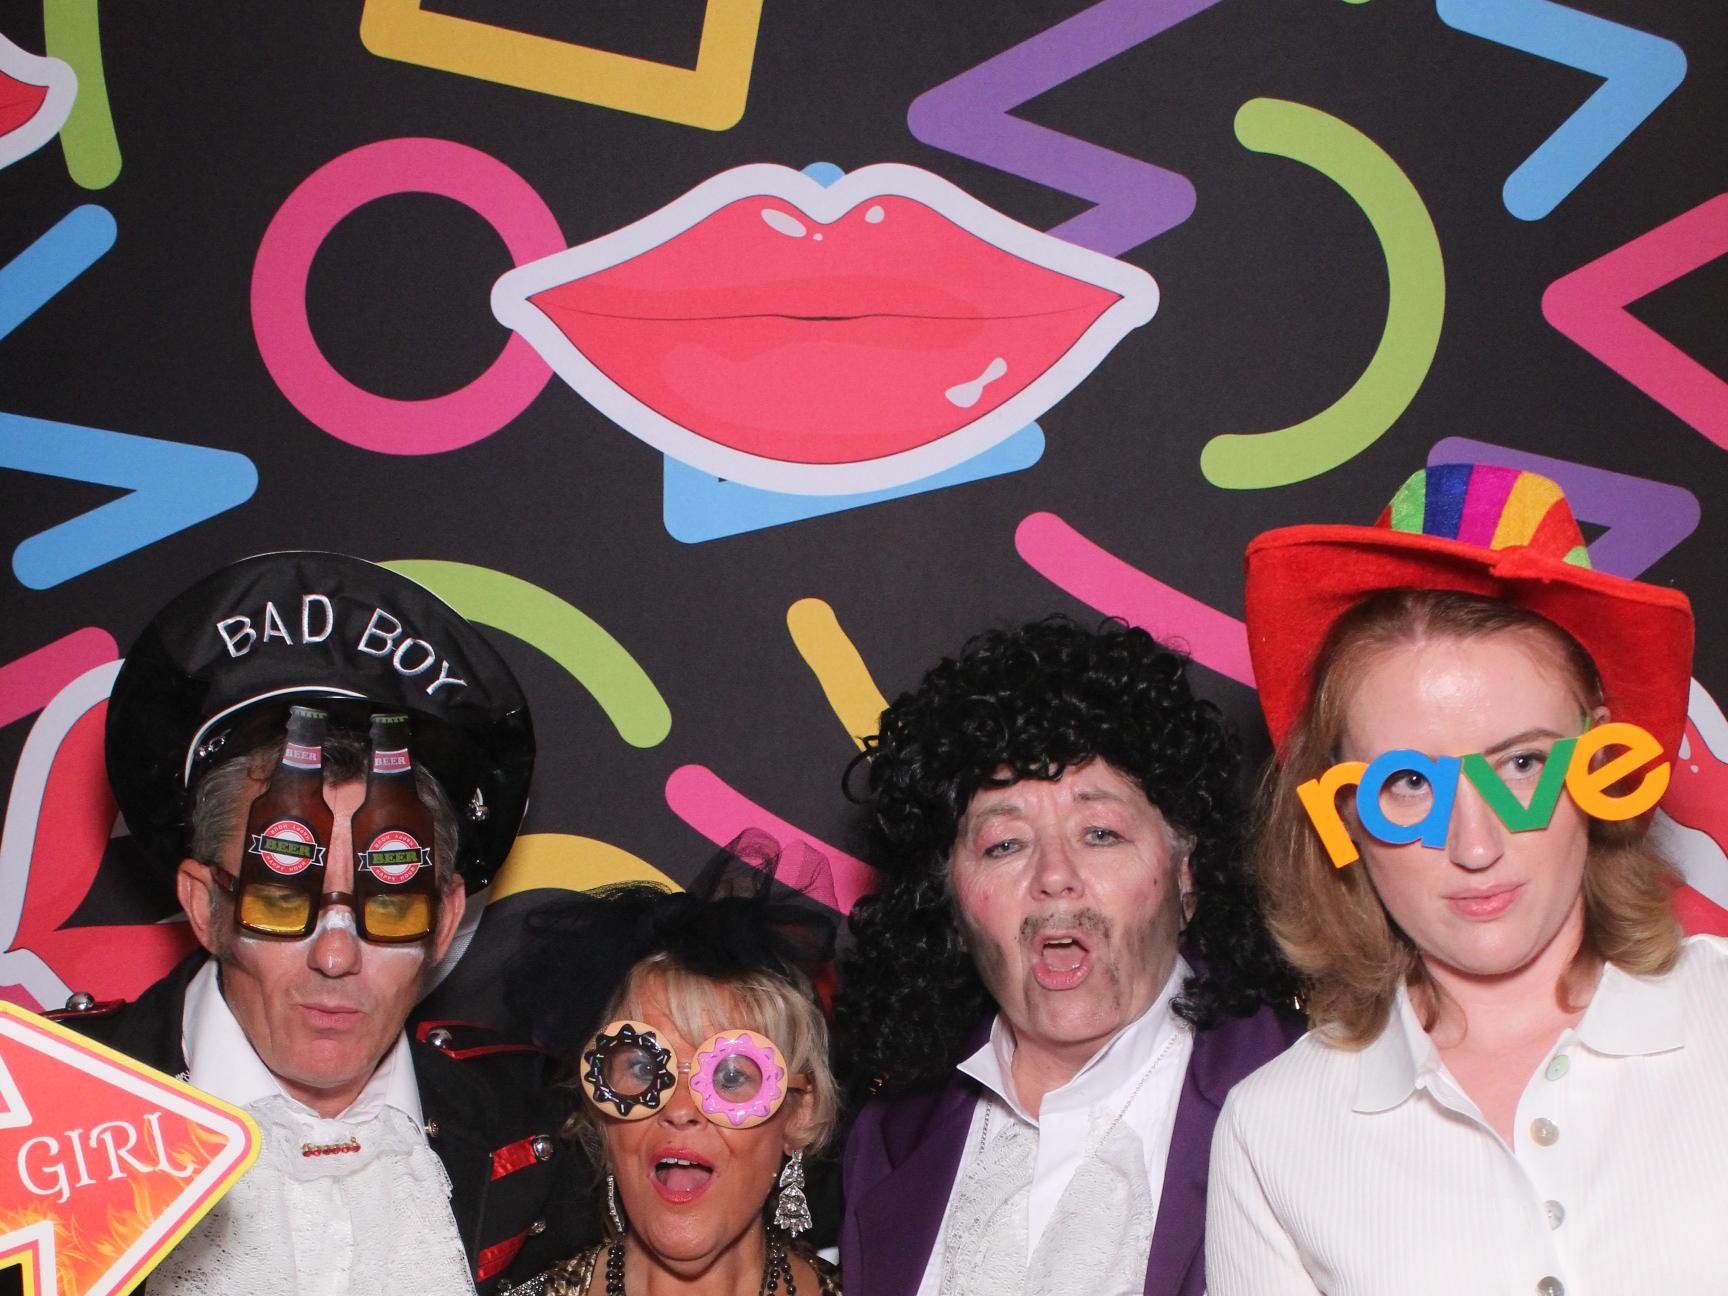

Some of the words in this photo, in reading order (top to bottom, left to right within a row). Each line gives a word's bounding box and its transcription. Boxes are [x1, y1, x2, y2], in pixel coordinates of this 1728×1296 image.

[217, 594, 333, 658] BAD
[357, 607, 467, 695] BOY
[285, 748, 317, 761] BEER
[375, 757, 406, 767] BEER
[1296, 722, 1671, 869] rave
[265, 838, 312, 858] BEER
[372, 851, 418, 864] BEER
[17, 1112, 196, 1203] GIRL
